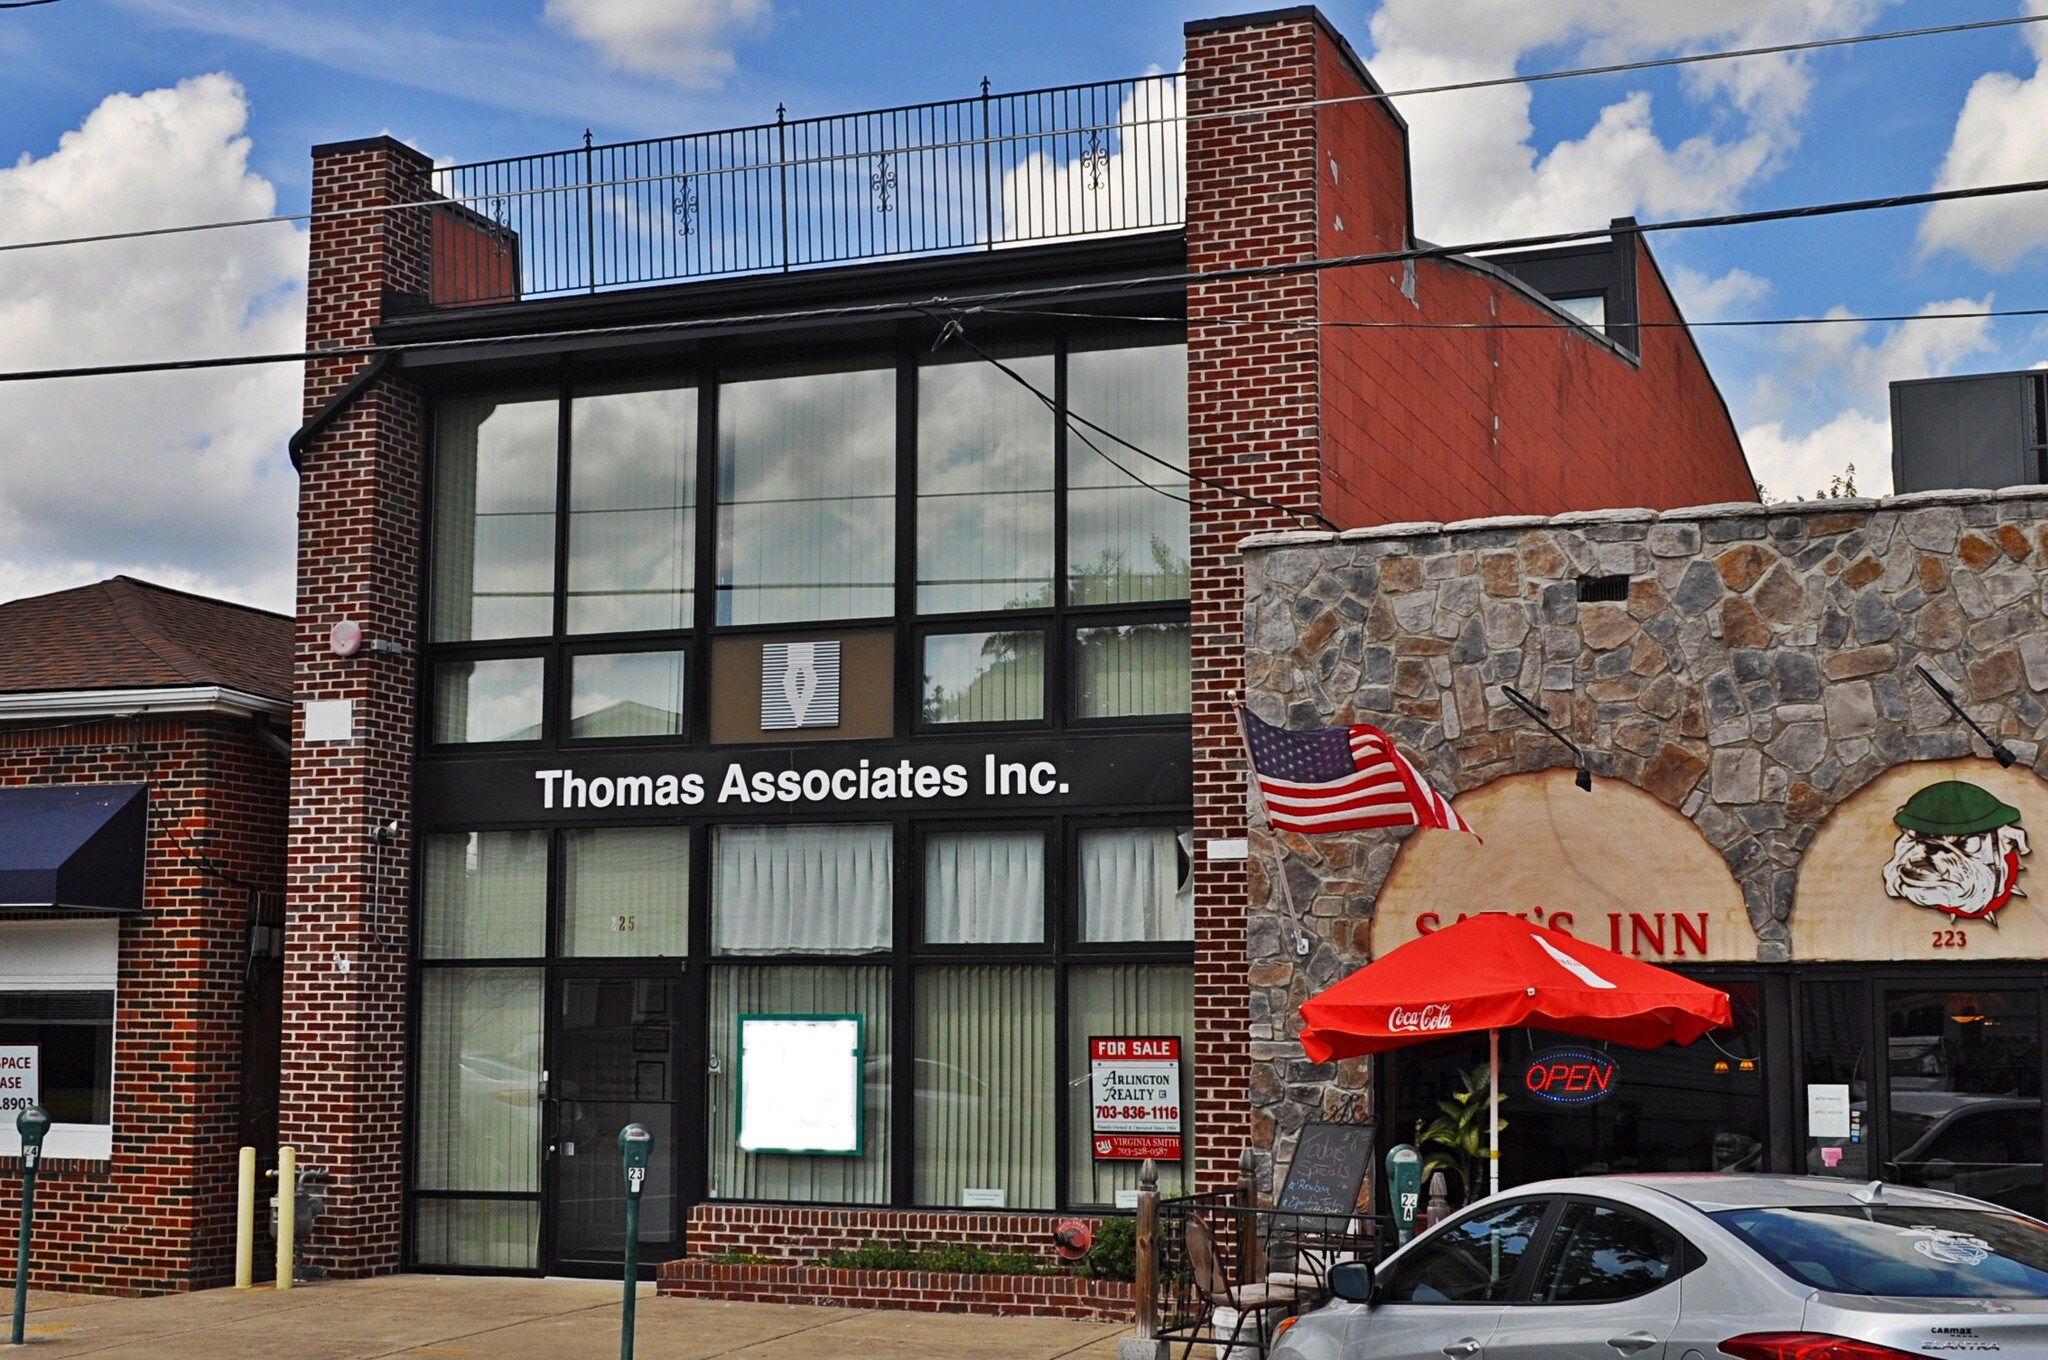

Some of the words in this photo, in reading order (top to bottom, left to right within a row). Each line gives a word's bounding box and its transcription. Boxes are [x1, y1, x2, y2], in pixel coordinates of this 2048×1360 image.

[535, 769, 705, 808] Thomas
[717, 759, 968, 803] Associates
[984, 754, 1070, 796] Inc.
[1606, 911, 1709, 955] INN
[1931, 930, 1967, 948] 223
[1388, 1004, 1452, 1032] Coca-Cola
[1098, 1041, 1127, 1056] FOR
[1132, 1041, 1171, 1056] SALE
[1102, 1070, 1170, 1087] ARLINGTON
[1525, 1064, 1614, 1092] OPEN
[1103, 1086, 1155, 1102] REALTY
[0, 1097, 34, 1111] 8903
[1095, 1105, 1179, 1120] 703-836-1116
[1113, 1138, 1152, 1147] VIRGINIA
[1152, 1138, 1180, 1148] SMITH
[629, 1168, 643, 1180] 23
[1405, 1208, 1412, 1220] A
[1921, 1341, 2000, 1351] ELANTRA
